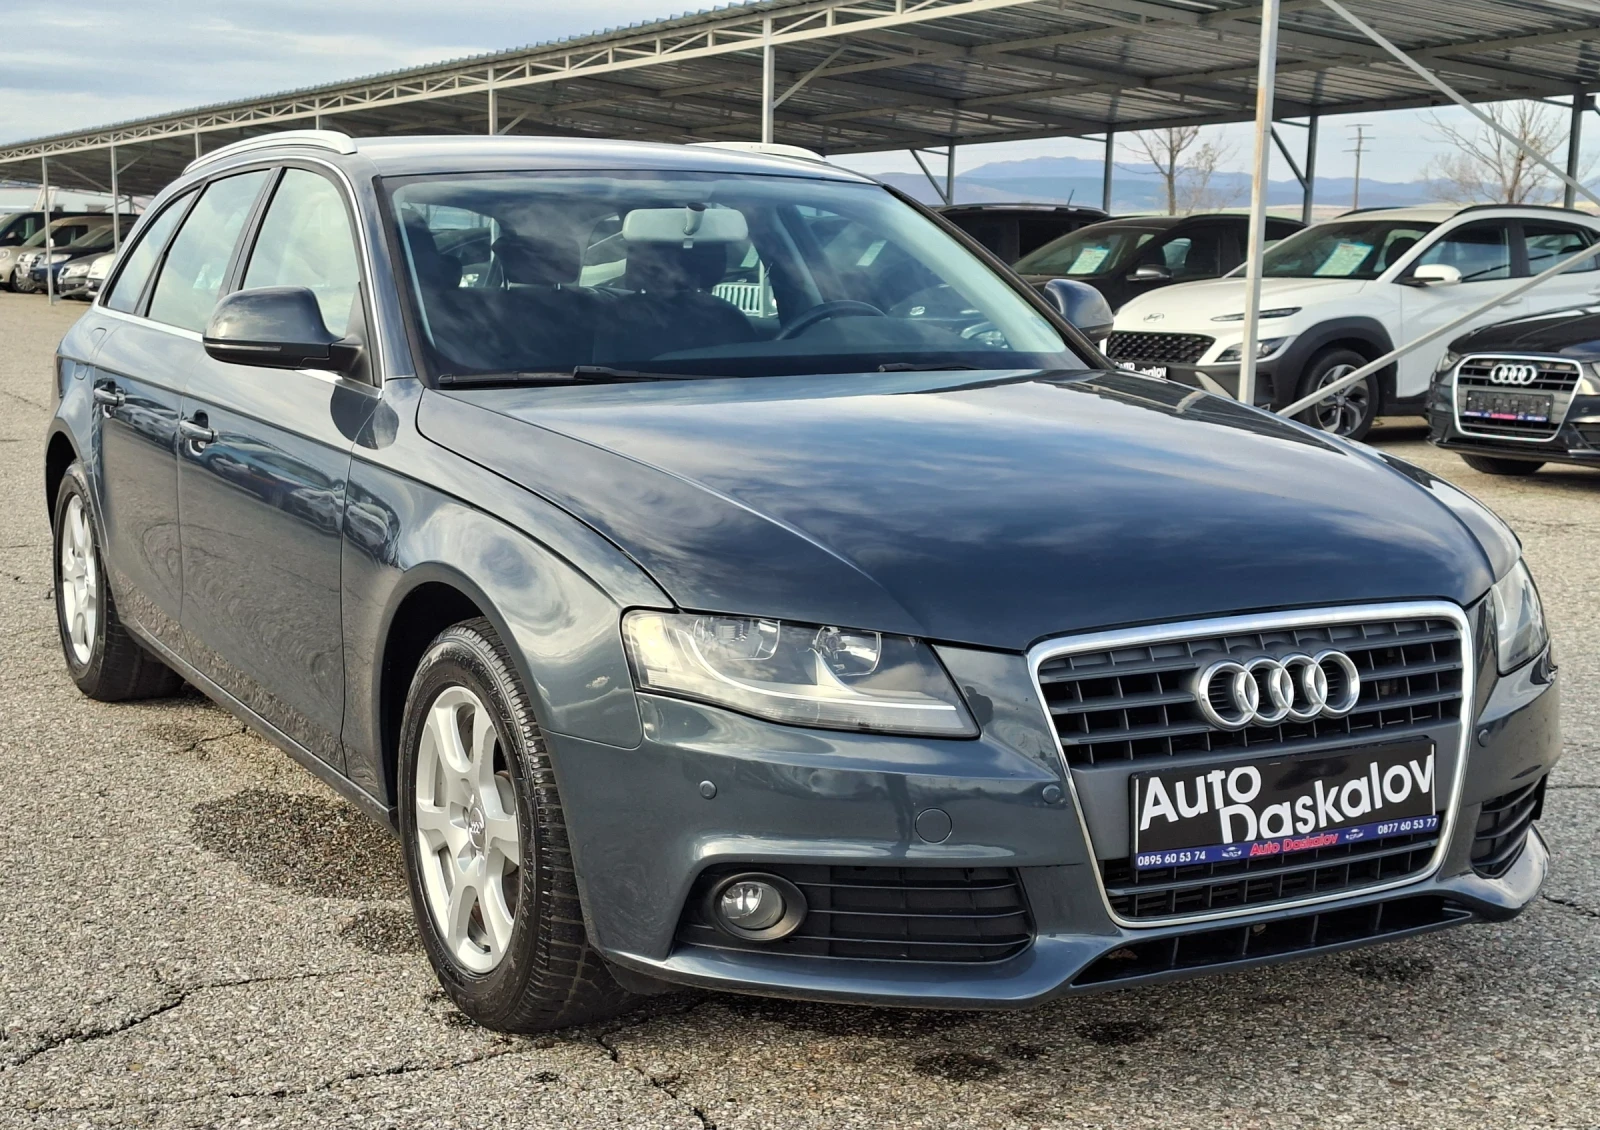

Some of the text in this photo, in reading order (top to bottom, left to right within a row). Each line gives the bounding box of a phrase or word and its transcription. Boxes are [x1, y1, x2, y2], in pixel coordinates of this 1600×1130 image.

[1139, 766, 1261, 831] Auto
[1219, 754, 1434, 844] Daskalov
[1377, 817, 1438, 835] 0877 60 53 77
[1249, 833, 1339, 856] Auto Daskalov
[1137, 850, 1206, 866] 0895 60 53 74
